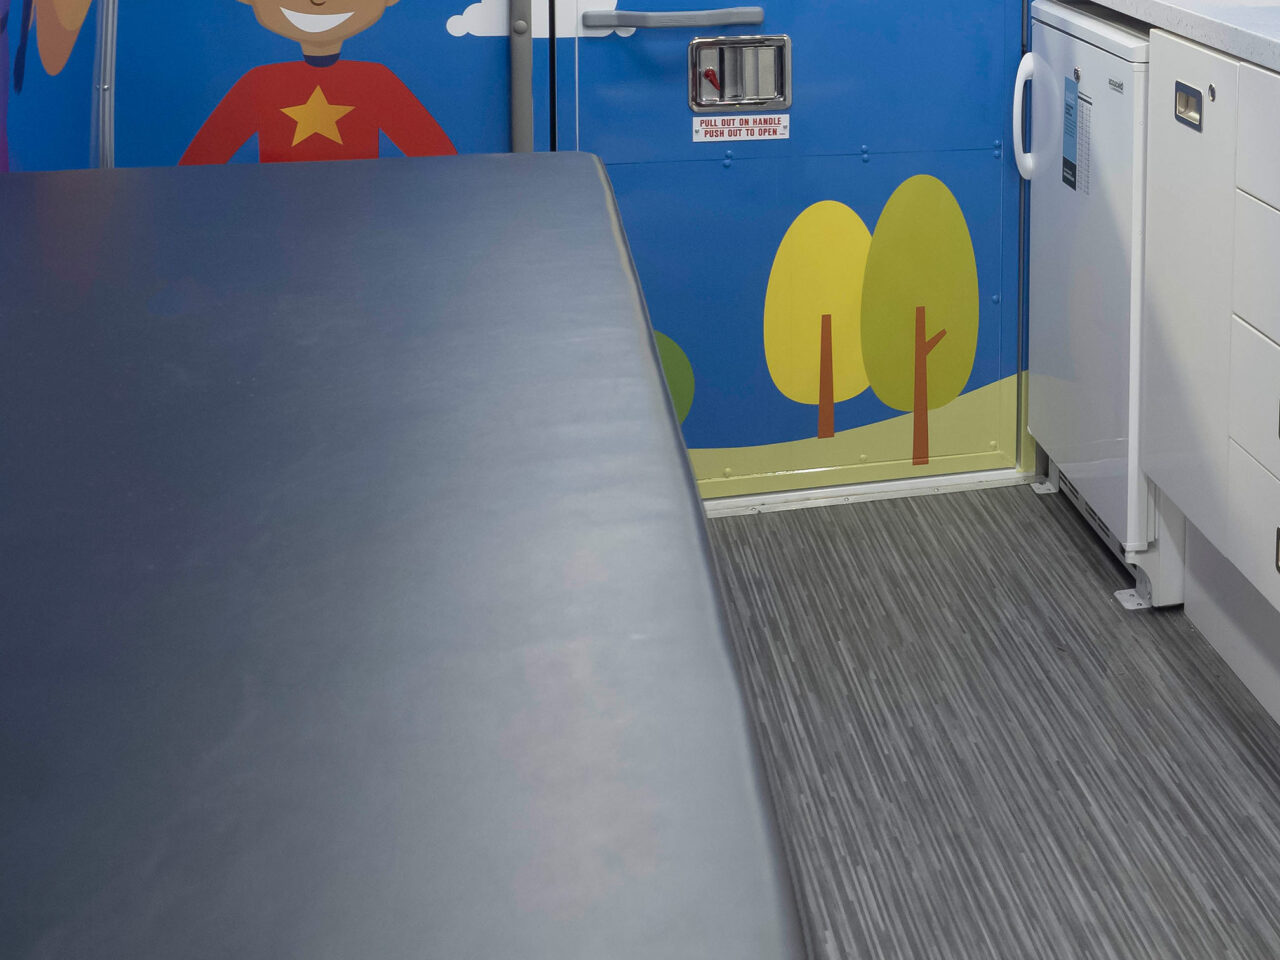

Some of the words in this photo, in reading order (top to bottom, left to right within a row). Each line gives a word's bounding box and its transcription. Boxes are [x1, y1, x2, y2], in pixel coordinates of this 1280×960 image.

[700, 119, 718, 127] PULL
[721, 119, 736, 127] OUT
[739, 118, 750, 126] ON
[752, 117, 782, 126] HANDLE
[704, 129, 724, 138] PUSH
[727, 129, 742, 137] OUT
[745, 128, 755, 136] TO
[758, 128, 777, 136] OPEN
